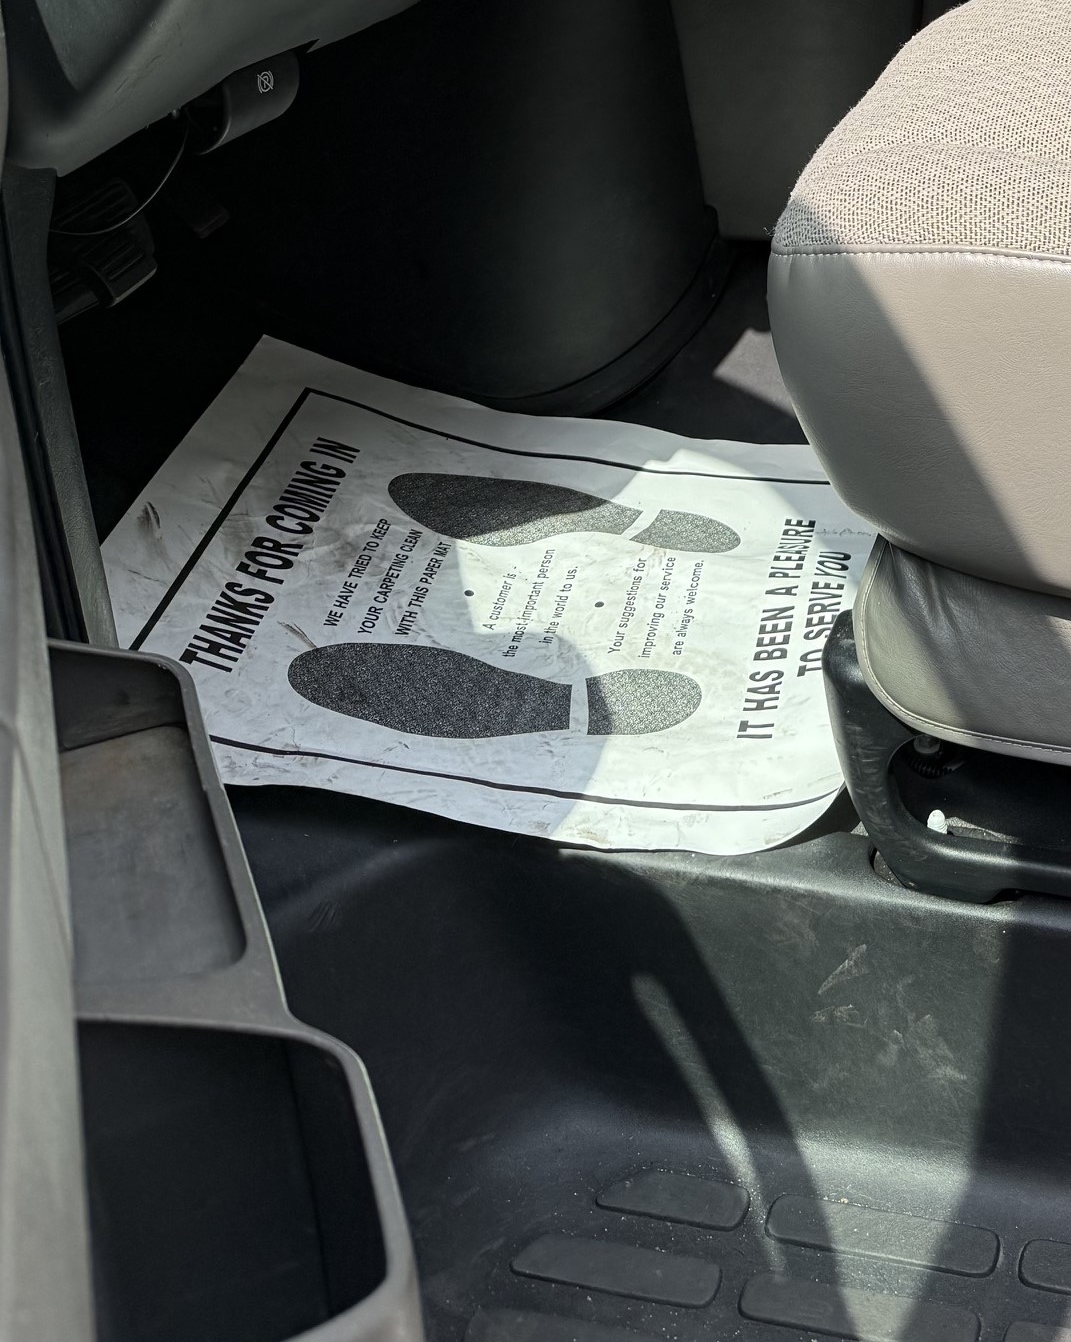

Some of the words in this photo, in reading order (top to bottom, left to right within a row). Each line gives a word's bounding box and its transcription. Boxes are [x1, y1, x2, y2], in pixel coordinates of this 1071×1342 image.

[310, 436, 360, 464] IN
[265, 460, 346, 535] COMING
[370, 518, 391, 540] KEEP
[236, 536, 304, 585] FOR
[363, 541, 380, 552] TO
[768, 518, 816, 579] PLEASURE
[348, 554, 372, 578] TRIED
[566, 566, 578, 580] us.
[660, 557, 676, 591] service
[814, 551, 852, 580] YOU
[333, 581, 358, 609] HAVE
[357, 606, 384, 634] YOUR
[373, 553, 409, 604] CARPETING
[400, 529, 423, 552] CLEAN
[395, 610, 418, 636] WITH
[408, 586, 429, 607] THIS
[420, 558, 443, 585] PAPER
[433, 542, 452, 558] MAT
[560, 583, 572, 592] to
[686, 560, 704, 605] welcome.
[765, 584, 799, 596] A
[489, 580, 513, 621] customer
[502, 645, 518, 658] the
[537, 549, 556, 579] person
[552, 595, 569, 618] world
[608, 631, 626, 654] Your
[619, 575, 643, 628] suggestions
[633, 558, 647, 572] for
[656, 593, 667, 609] our
[803, 581, 845, 642] SERVE
[179, 581, 275, 673] THANKS
[323, 610, 344, 626] WE
[544, 621, 560, 634] the
[676, 608, 694, 638] always
[538, 636, 554, 644] in
[638, 612, 665, 658] improving
[672, 640, 684, 656] are
[752, 606, 795, 662] BEEN
[797, 648, 823, 678] TO
[742, 669, 784, 712] HAS
[736, 720, 775, 739] IT
